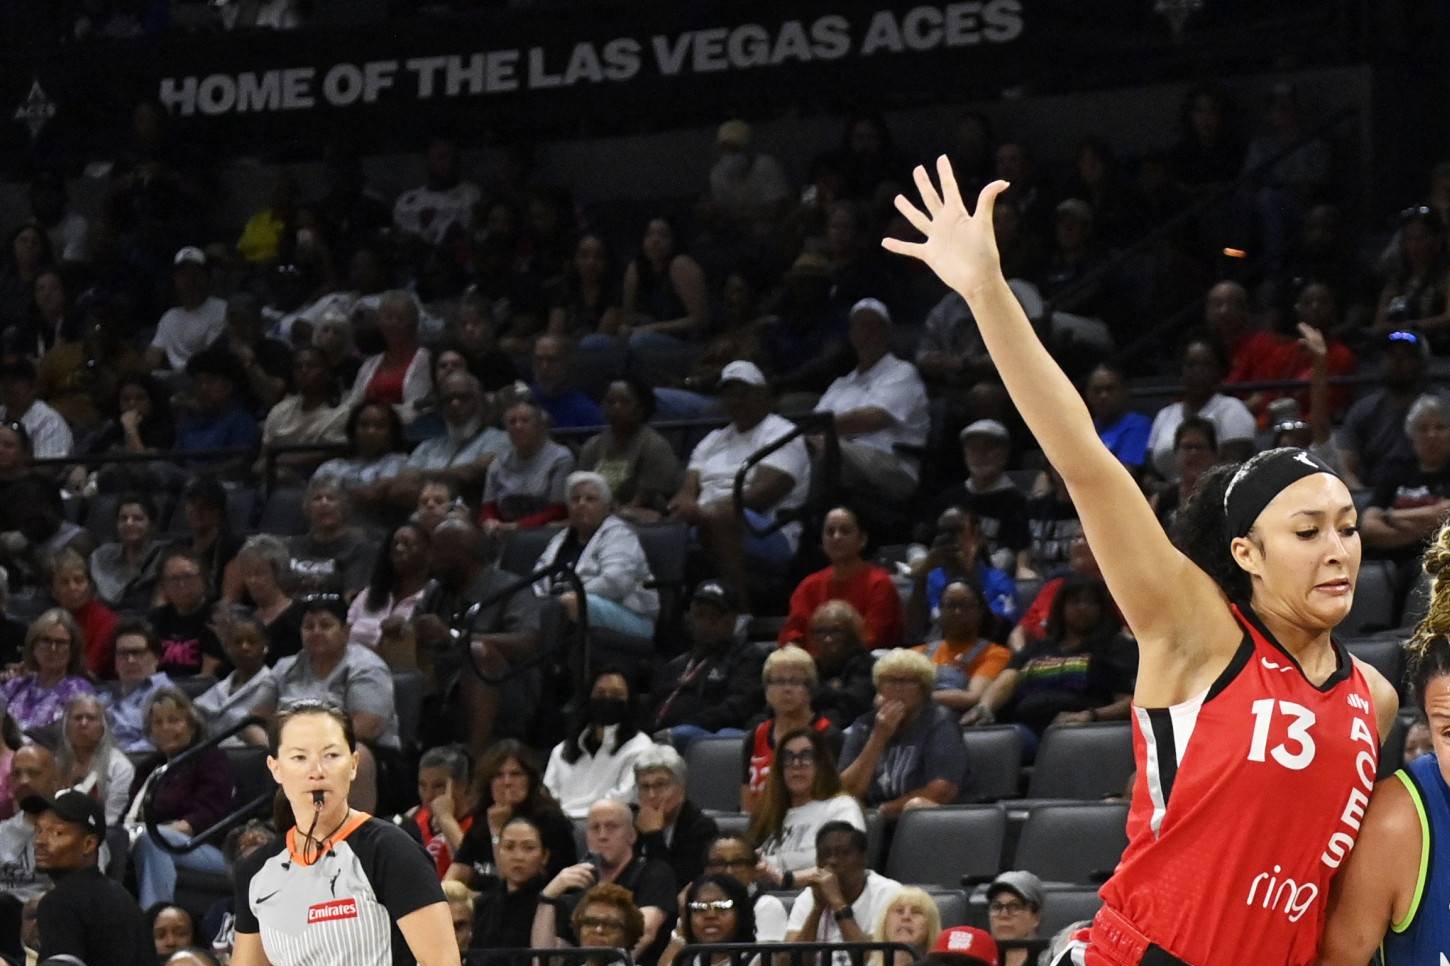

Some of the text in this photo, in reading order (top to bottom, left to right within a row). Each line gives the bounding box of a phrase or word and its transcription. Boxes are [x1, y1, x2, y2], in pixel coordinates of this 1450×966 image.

[159, 0, 1025, 117] HOME OF THE LAS VEGAS ACES
[1247, 698, 1317, 770] 13
[1321, 716, 1377, 869] ACES
[308, 902, 357, 920] Emirates
[1246, 864, 1319, 923] ring
